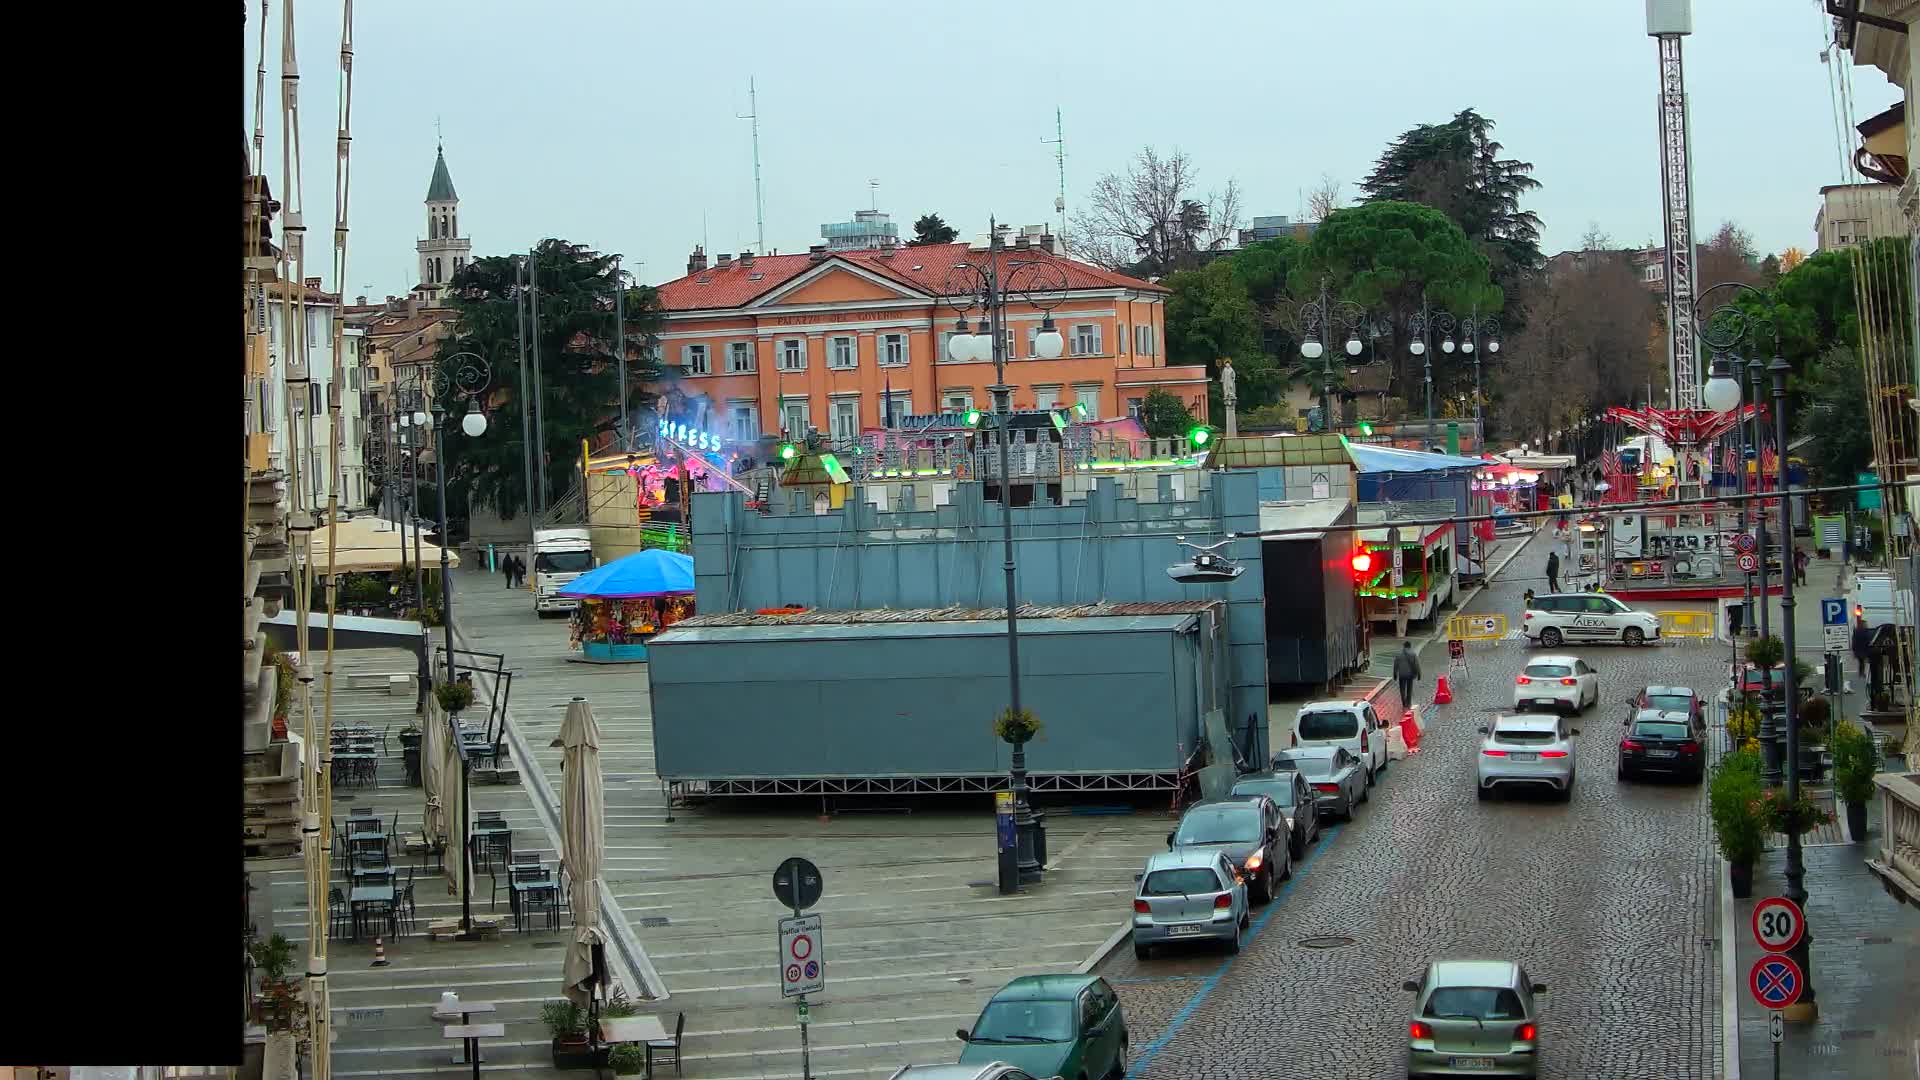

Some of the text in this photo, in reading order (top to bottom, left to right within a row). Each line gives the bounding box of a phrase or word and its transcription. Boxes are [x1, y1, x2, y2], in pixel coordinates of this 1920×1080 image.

[777, 310, 904, 326] PALAZZO DEL GOVERNO
[1742, 557, 1752, 567] 20
[1827, 602, 1842, 622] P
[1574, 615, 1606, 627] ALEXA
[1762, 911, 1791, 938] 30
[790, 969, 798, 978] 20
